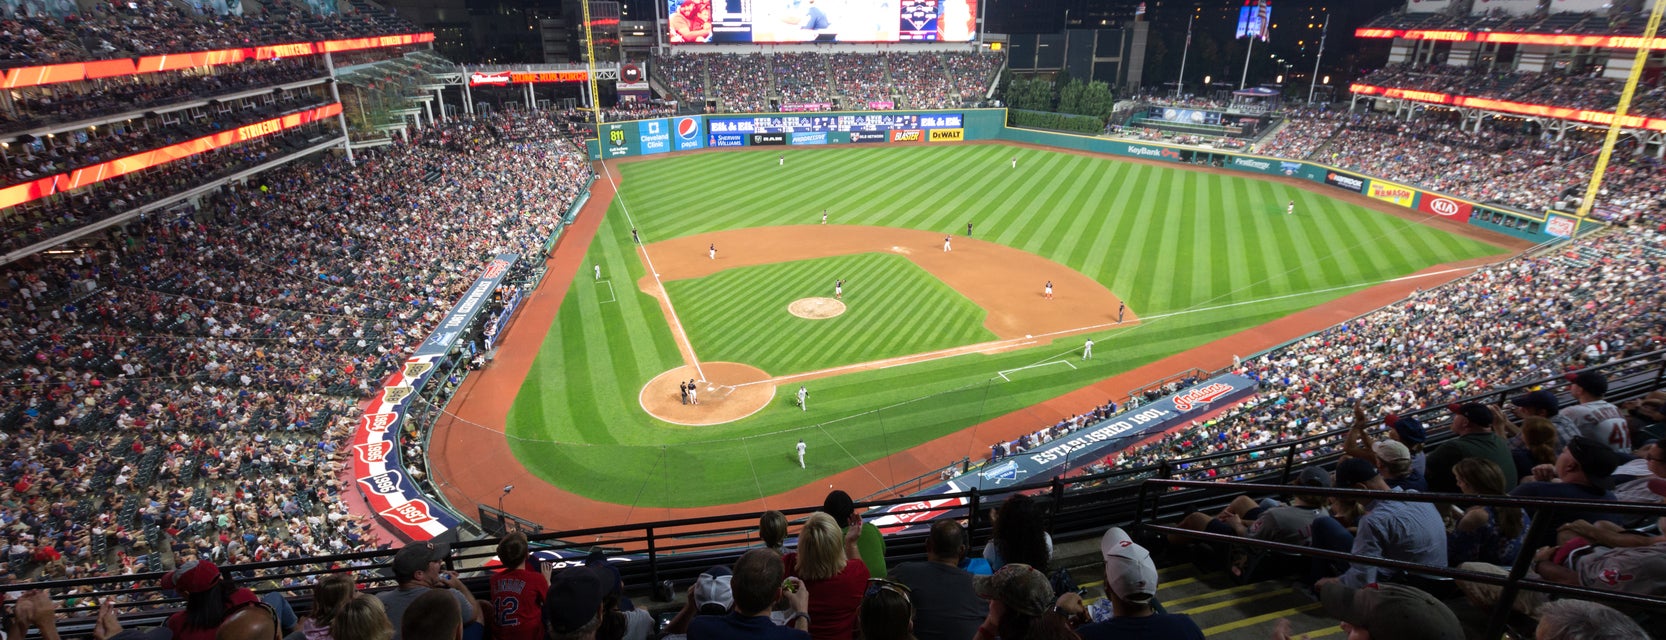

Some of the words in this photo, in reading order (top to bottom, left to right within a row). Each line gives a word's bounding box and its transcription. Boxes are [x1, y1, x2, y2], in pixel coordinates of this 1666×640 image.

[512, 72, 538, 83] HOME
[540, 72, 557, 82] RUN
[559, 72, 588, 82] PORCH
[238, 118, 282, 140] STRIKEOUT
[610, 130, 625, 141] 811
[641, 134, 669, 142] Cleveland
[647, 141, 664, 149] Clinic
[681, 140, 698, 149] pepsi
[1128, 145, 1161, 156] KeyBank
[1434, 200, 1454, 214] KIA
[1172, 382, 1234, 411] Indians
[371, 413, 389, 432] 1954
[1030, 421, 1134, 465] ESTABLISHED
[1127, 408, 1170, 429] 1901.
[367, 442, 384, 462] 1995
[373, 474, 395, 493] 1996
[397, 503, 428, 523] 1997
[493, 596, 519, 626] 12
